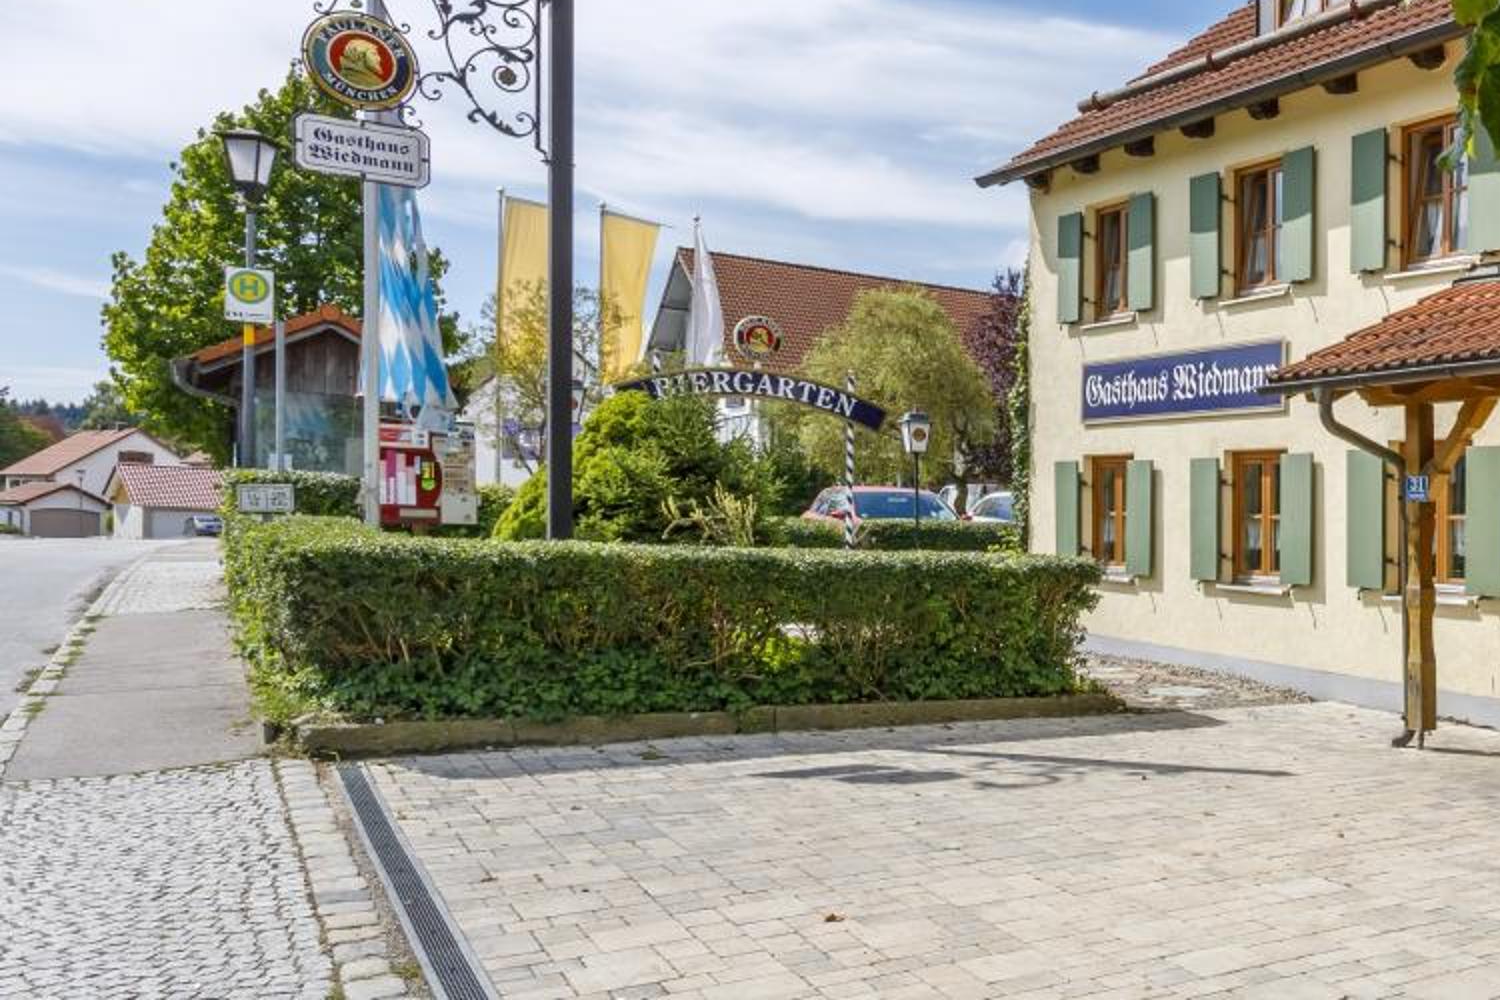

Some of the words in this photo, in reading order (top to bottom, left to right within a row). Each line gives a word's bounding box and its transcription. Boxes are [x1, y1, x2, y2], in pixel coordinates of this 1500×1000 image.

[313, 127, 410, 155] Gasthaus
[308, 143, 414, 173] Wiedmann
[240, 280, 258, 297] H
[1085, 369, 1168, 408] Gasthaus
